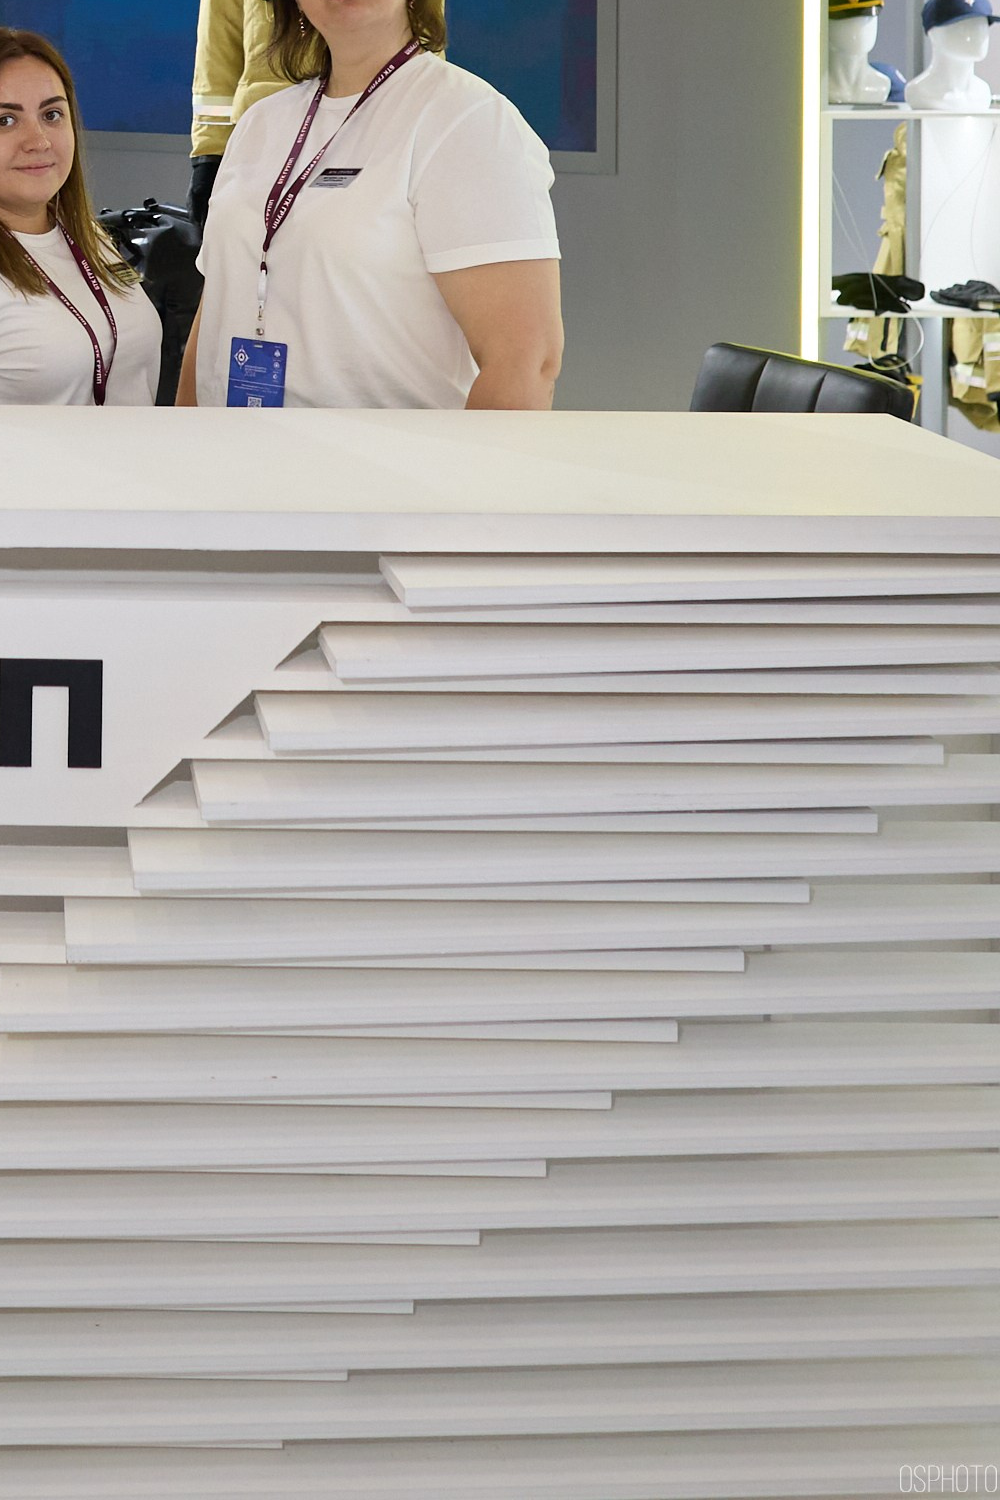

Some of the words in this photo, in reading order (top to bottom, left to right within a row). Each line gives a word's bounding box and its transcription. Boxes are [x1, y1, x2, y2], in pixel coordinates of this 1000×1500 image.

[383, 64, 395, 76] БТК
[367, 74, 385, 93] ГРУПП
[283, 193, 294, 207] БТК
[271, 206, 287, 230] ГРУПП
[81, 259, 96, 280] ГРУПП
[90, 278, 101, 291] БТК
